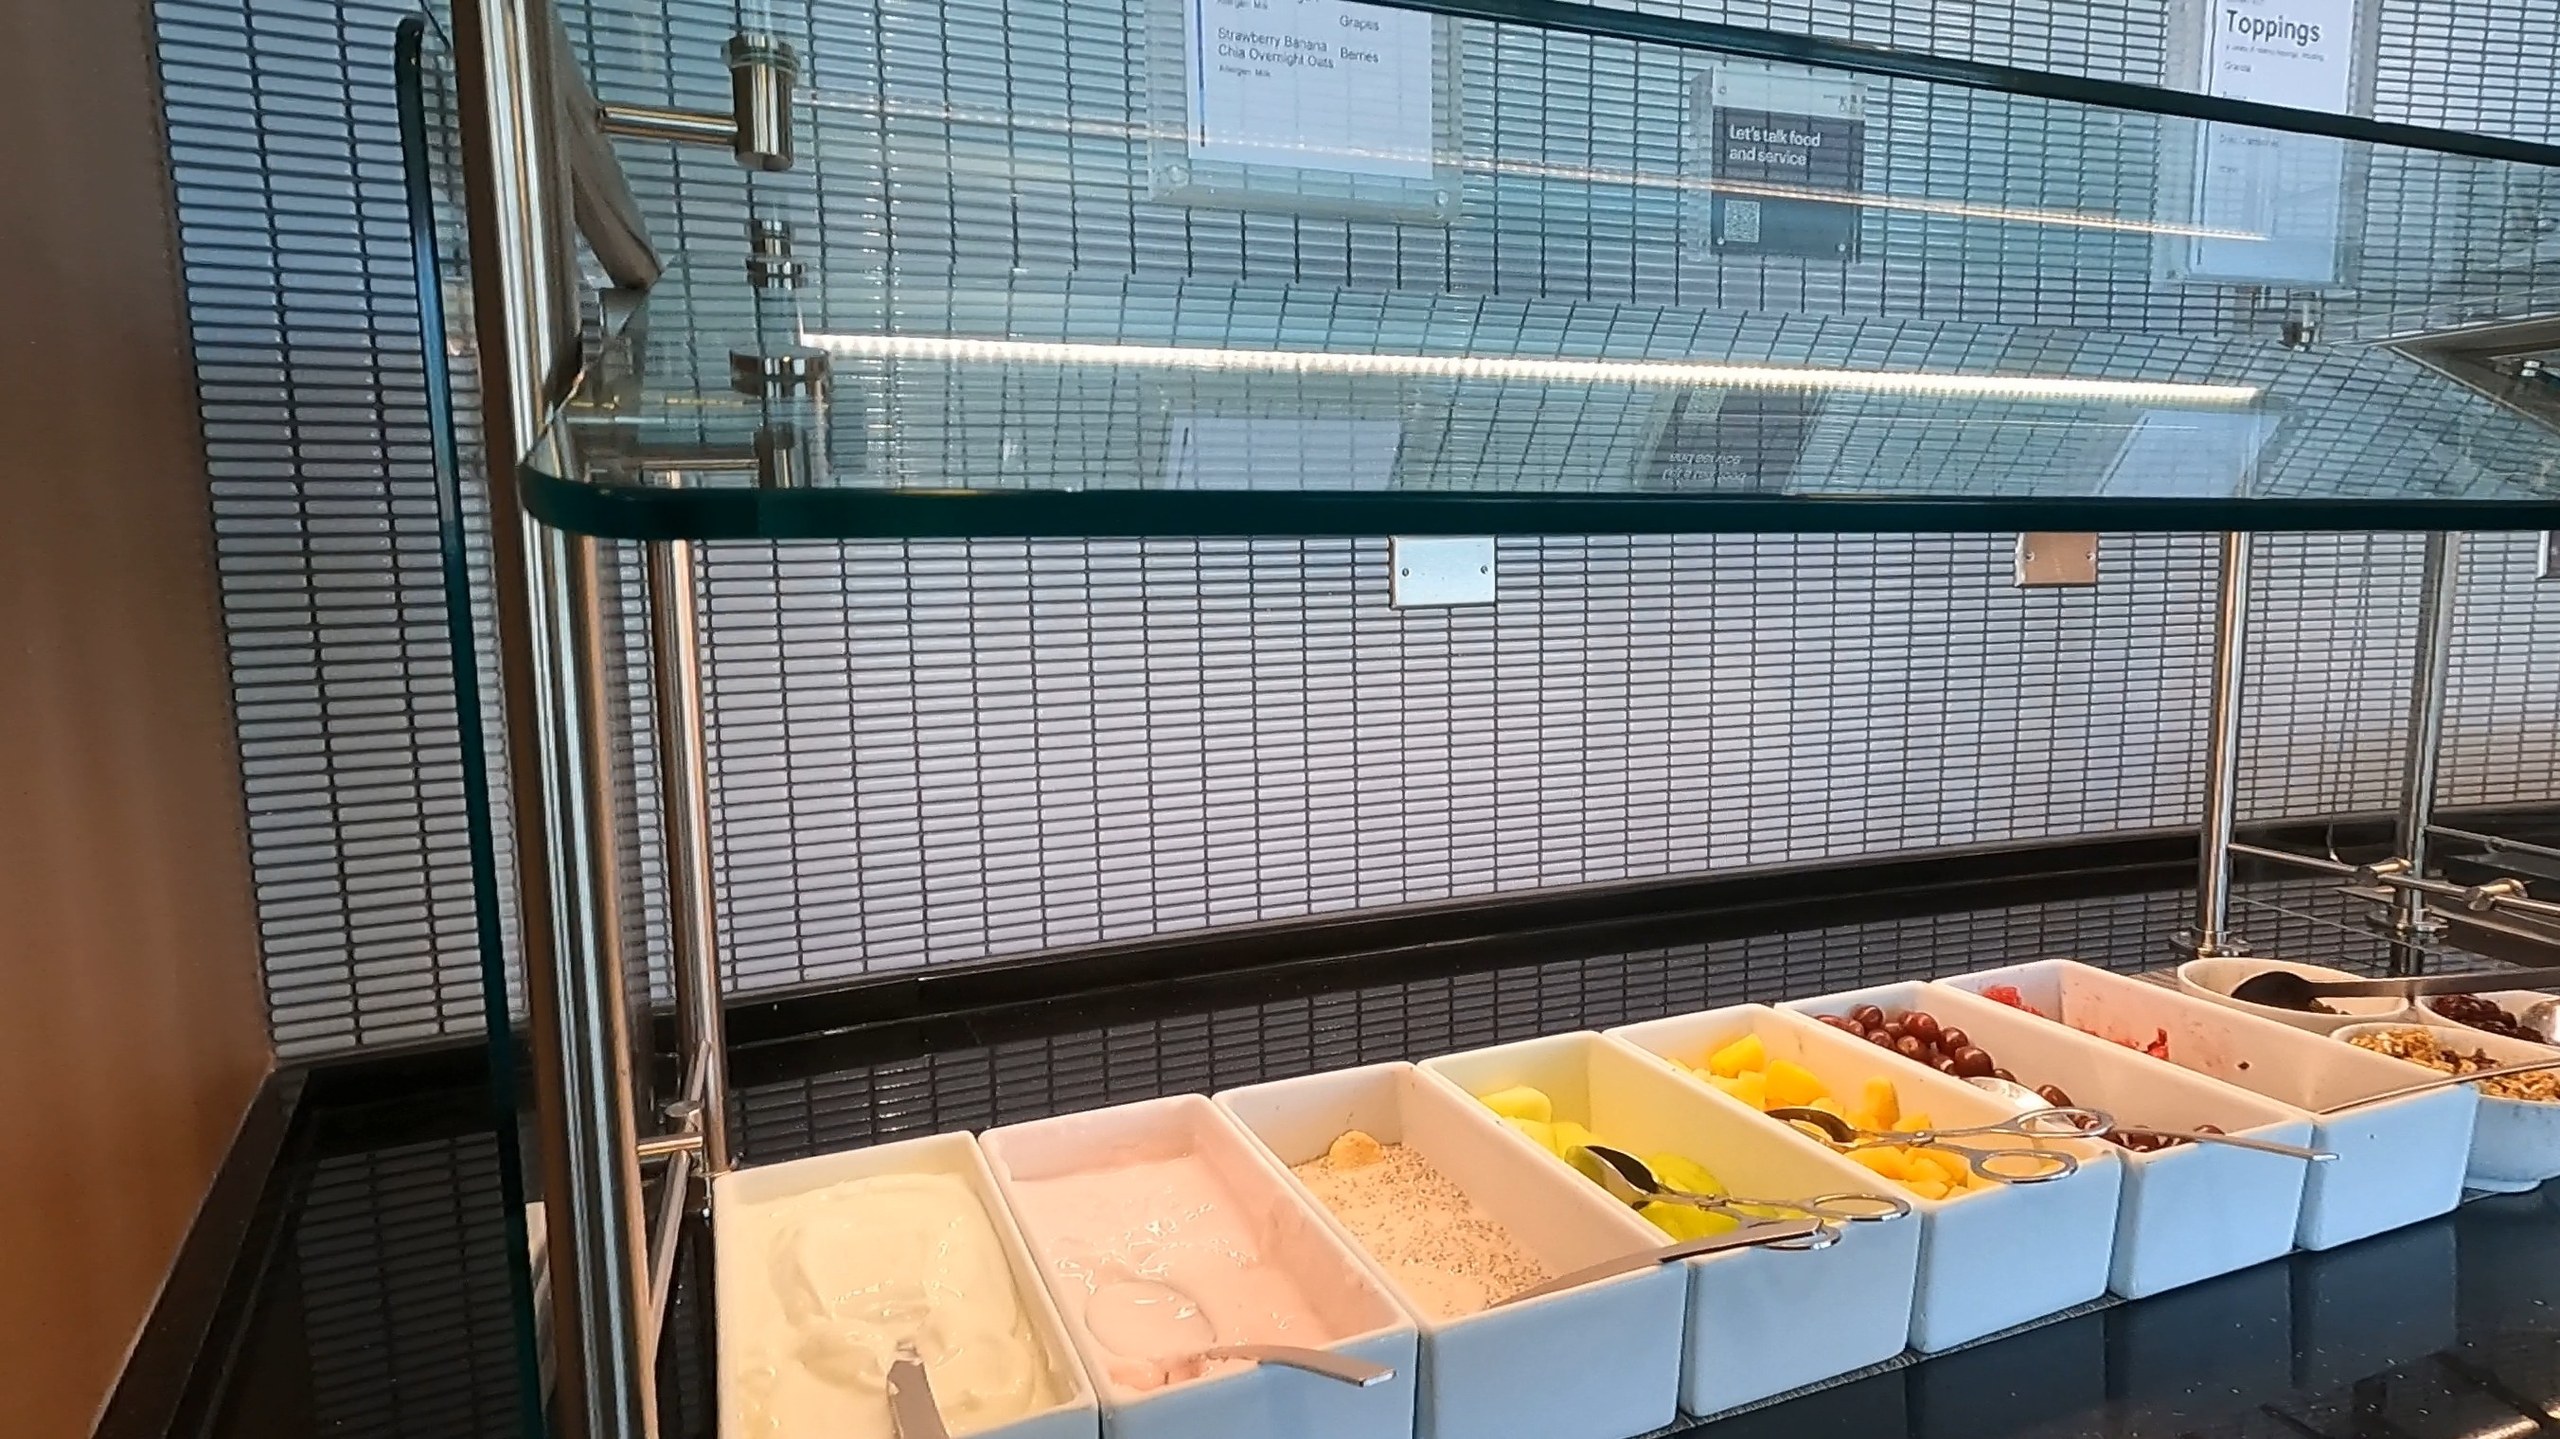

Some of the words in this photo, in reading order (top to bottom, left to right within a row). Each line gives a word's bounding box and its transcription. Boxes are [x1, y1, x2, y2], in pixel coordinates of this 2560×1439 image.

[1339, 15, 1379, 31] Grapes
[2226, 9, 2320, 47] Toppings
[1217, 27, 1281, 49] Strawberry
[1284, 35, 1328, 52] Banana
[1218, 43, 1246, 58] Chia
[1249, 48, 1304, 66] Overnight
[1308, 55, 1334, 68] Oats
[1340, 46, 1379, 63] Berries
[1730, 124, 1761, 141] Let's
[1763, 129, 1788, 144] talk
[1789, 130, 1820, 147] food
[1729, 147, 1756, 162] and
[1757, 150, 1806, 166] service
